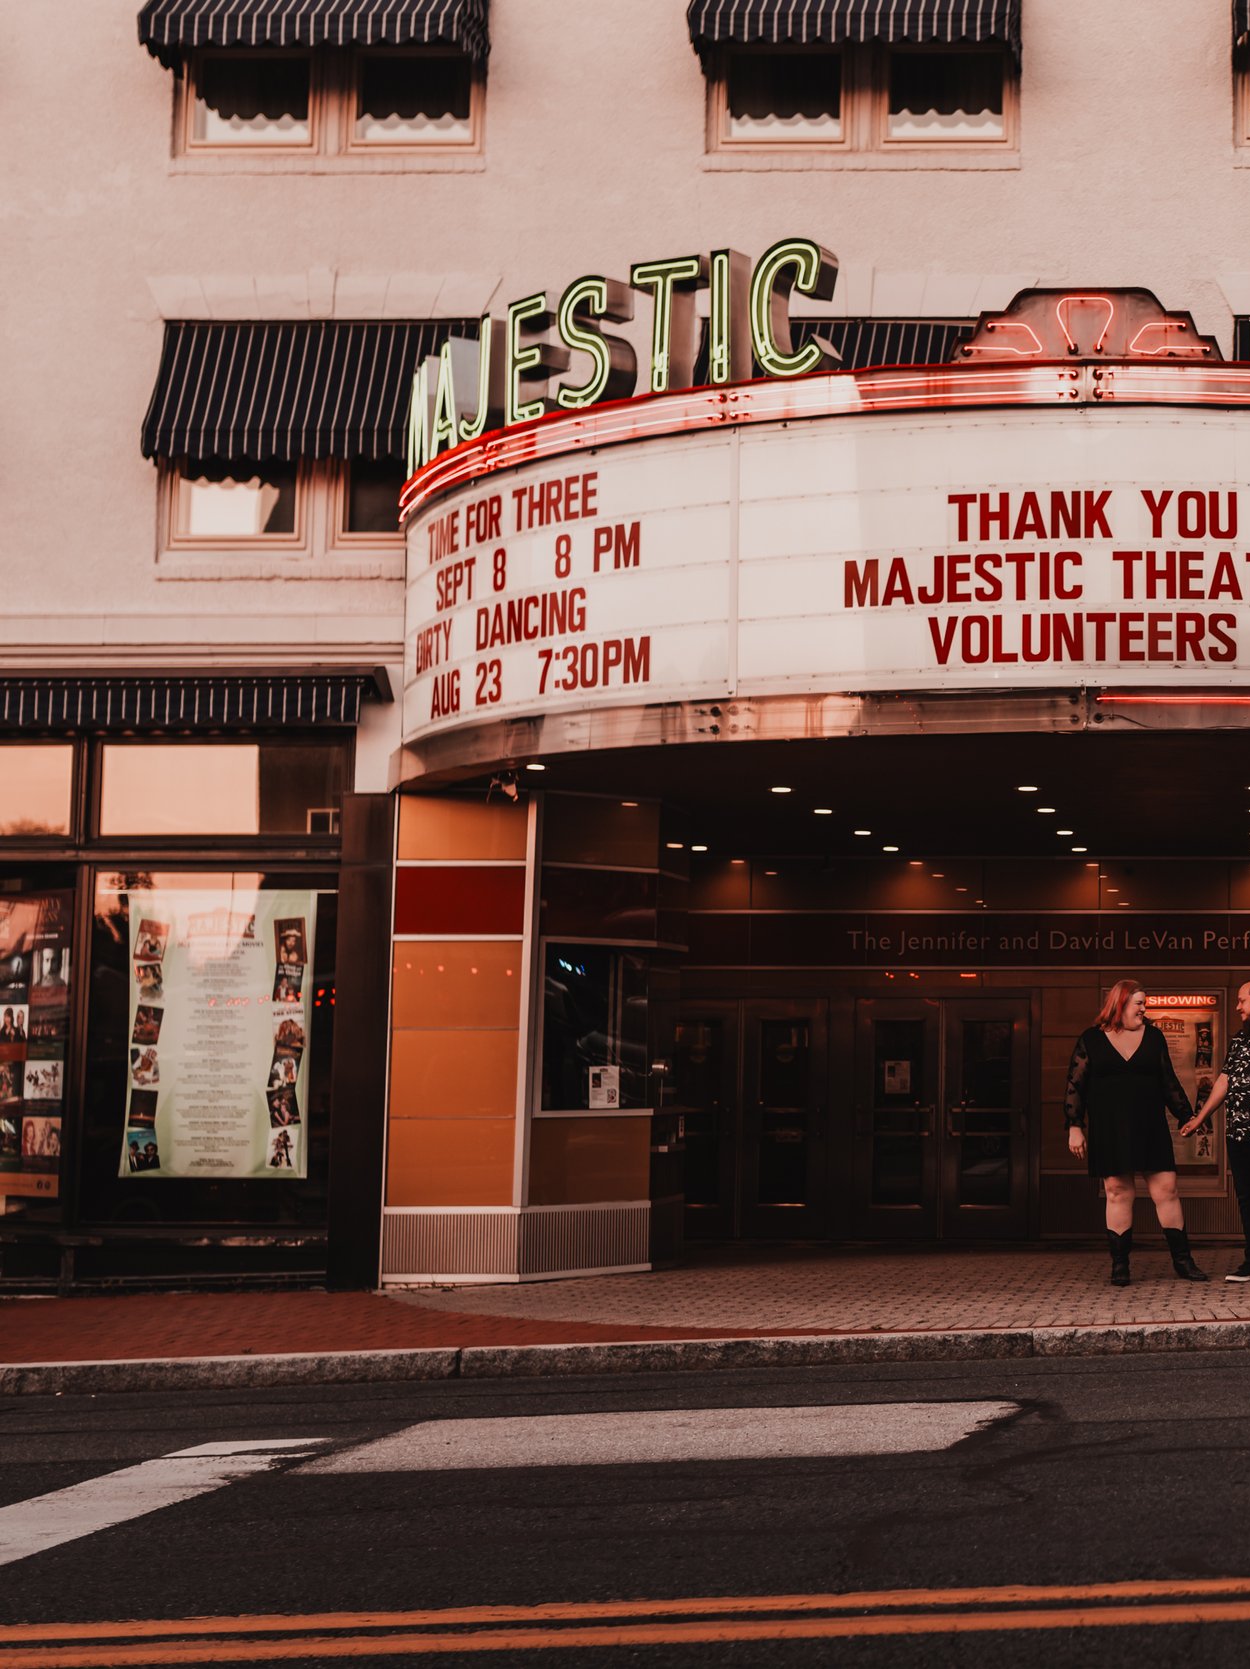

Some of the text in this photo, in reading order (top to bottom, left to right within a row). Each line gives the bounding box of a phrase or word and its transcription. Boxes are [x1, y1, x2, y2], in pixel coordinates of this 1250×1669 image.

[407, 238, 828, 480] MAJESTIC
[428, 471, 598, 564] TIME FOR THREE
[948, 490, 1238, 542] THANK YOU
[436, 521, 641, 612] SEPT 8 8 PM
[844, 551, 1084, 608] MAJESTIC
[416, 587, 586, 675] DIRTY DANCING
[928, 612, 1238, 665] VOLUNTEERS
[430, 668, 460, 720] AUG
[475, 659, 502, 706] 23
[847, 930, 891, 950] The
[898, 930, 991, 956] Jennifer
[999, 931, 1039, 950] and
[1049, 930, 1115, 950] David
[1125, 930, 1193, 950] LeVan
[1148, 995, 1217, 1005] SHOWING
